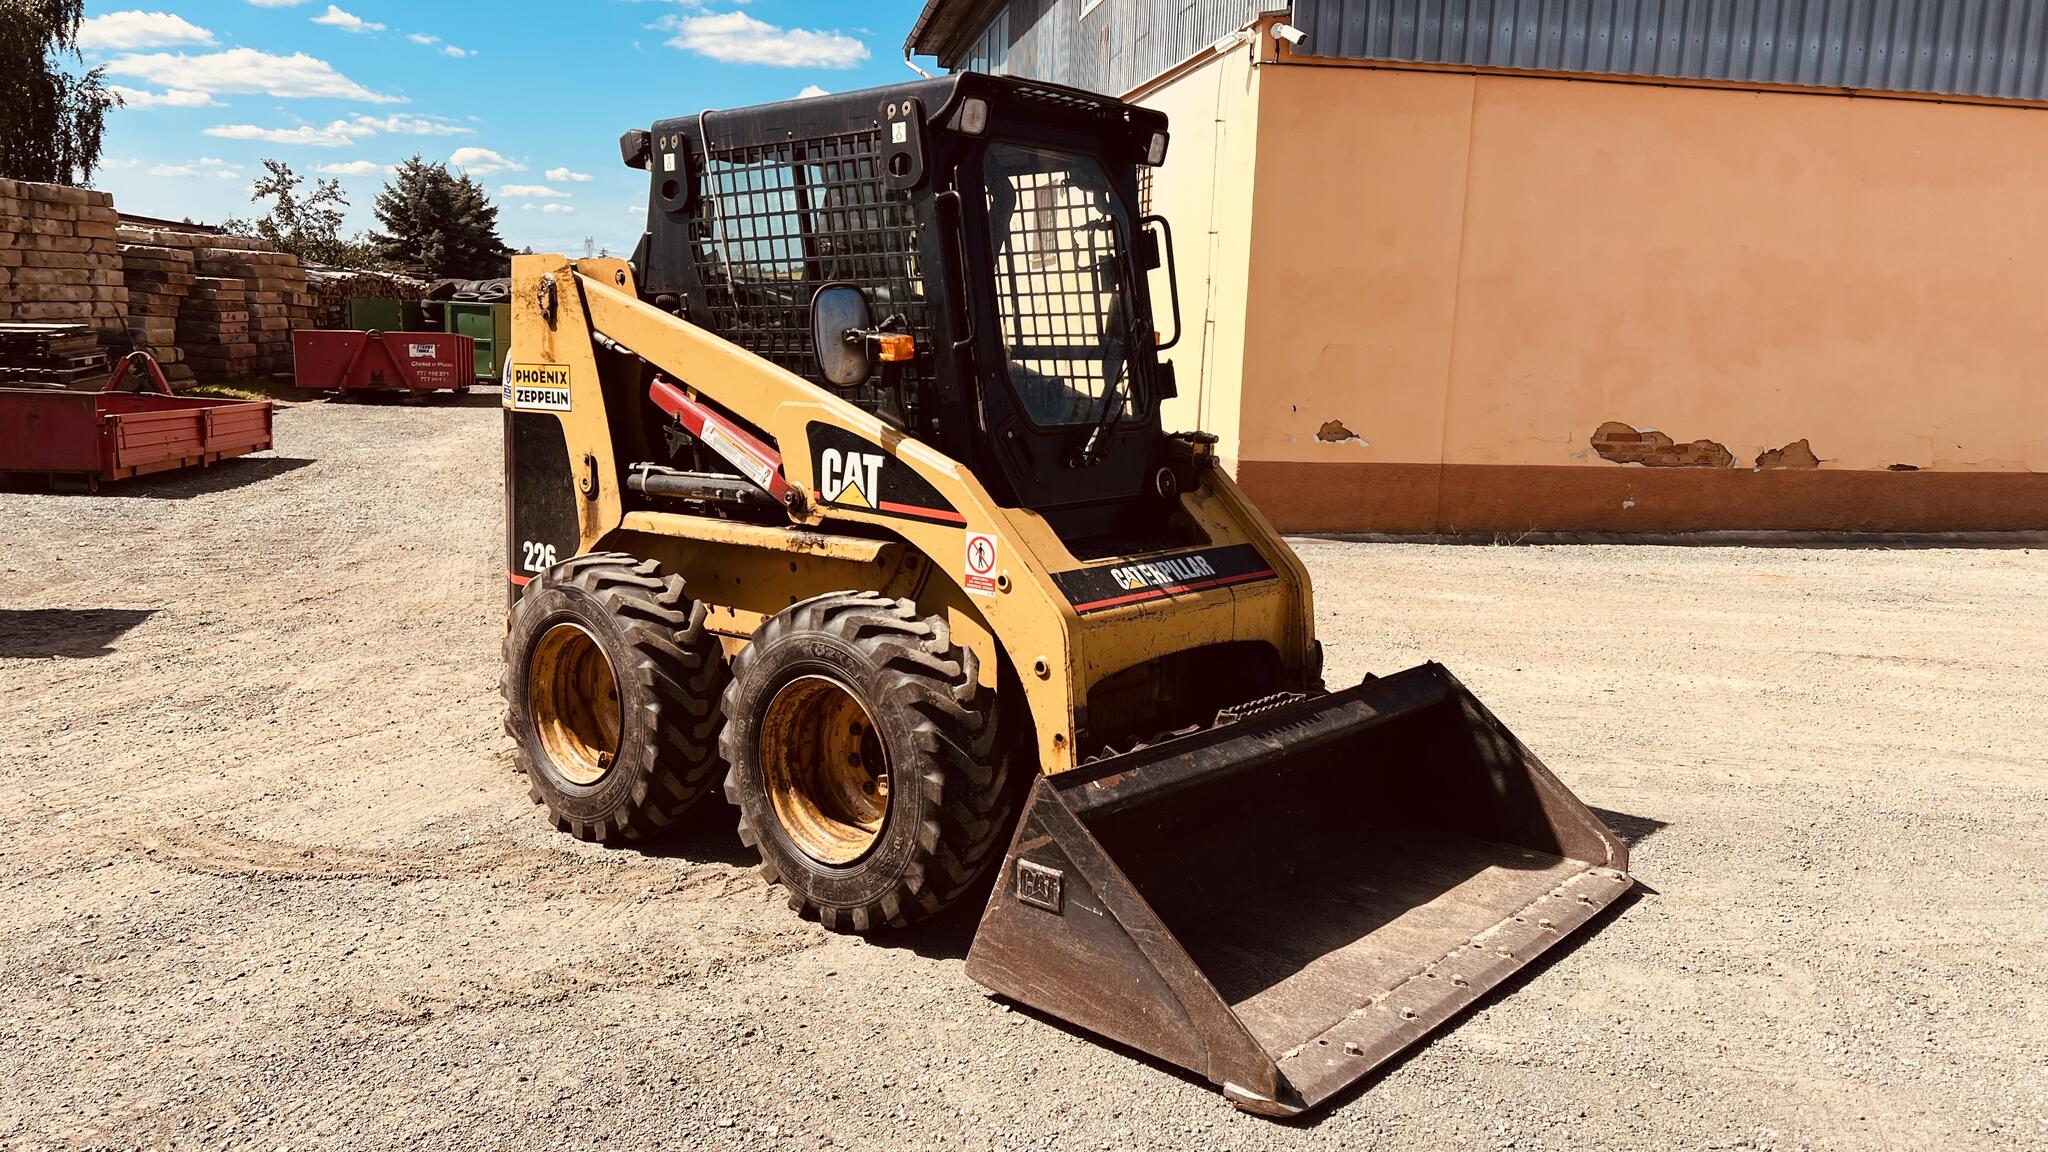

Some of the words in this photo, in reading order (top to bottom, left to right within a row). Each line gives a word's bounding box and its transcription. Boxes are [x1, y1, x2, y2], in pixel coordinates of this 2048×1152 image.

[515, 369, 568, 385] PHOENIX
[516, 389, 569, 406] ZEPPELIN
[821, 447, 884, 509] CAT
[522, 540, 557, 573] 226
[1110, 555, 1217, 591] CATERPILLAR
[1020, 867, 1060, 906] CAT
